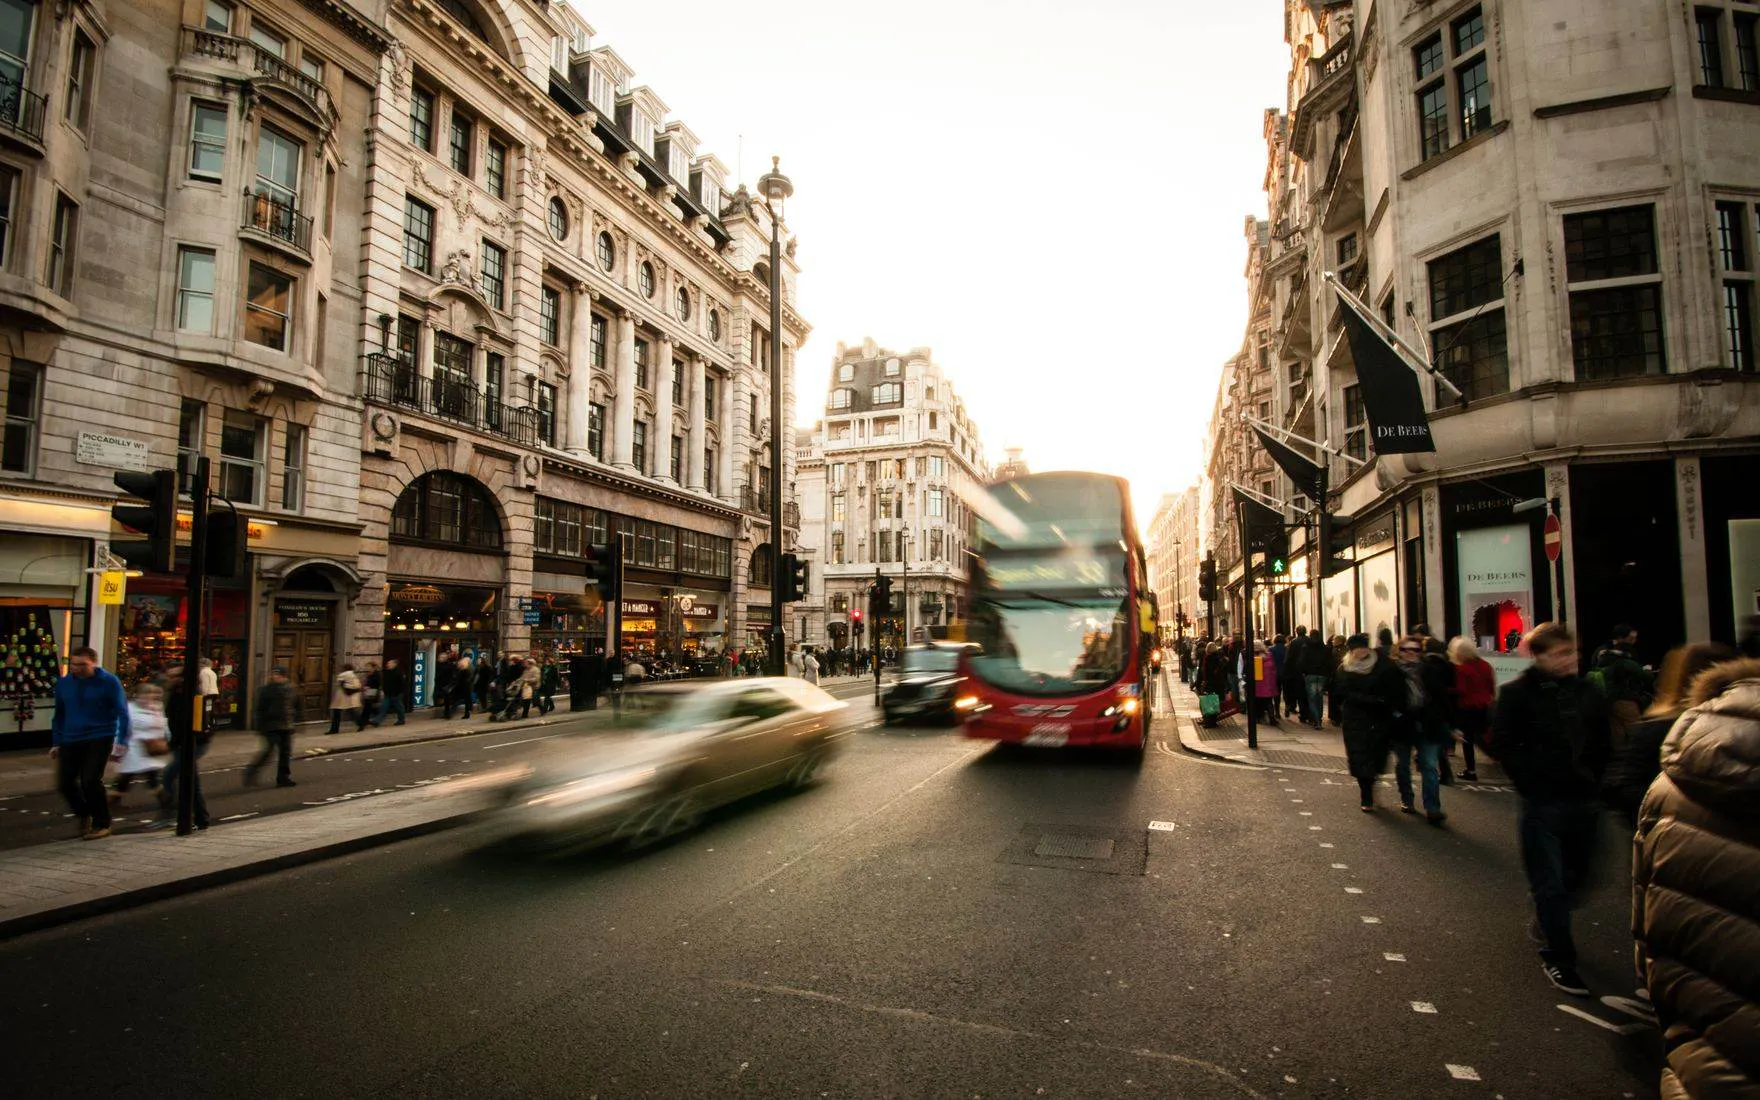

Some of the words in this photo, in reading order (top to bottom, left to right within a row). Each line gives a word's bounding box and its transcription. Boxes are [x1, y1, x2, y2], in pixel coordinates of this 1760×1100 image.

[82, 432, 131, 447] PICCADILLY
[104, 580, 119, 593] itsu
[632, 603, 649, 613] MANGER
[414, 652, 424, 705] MONEY
